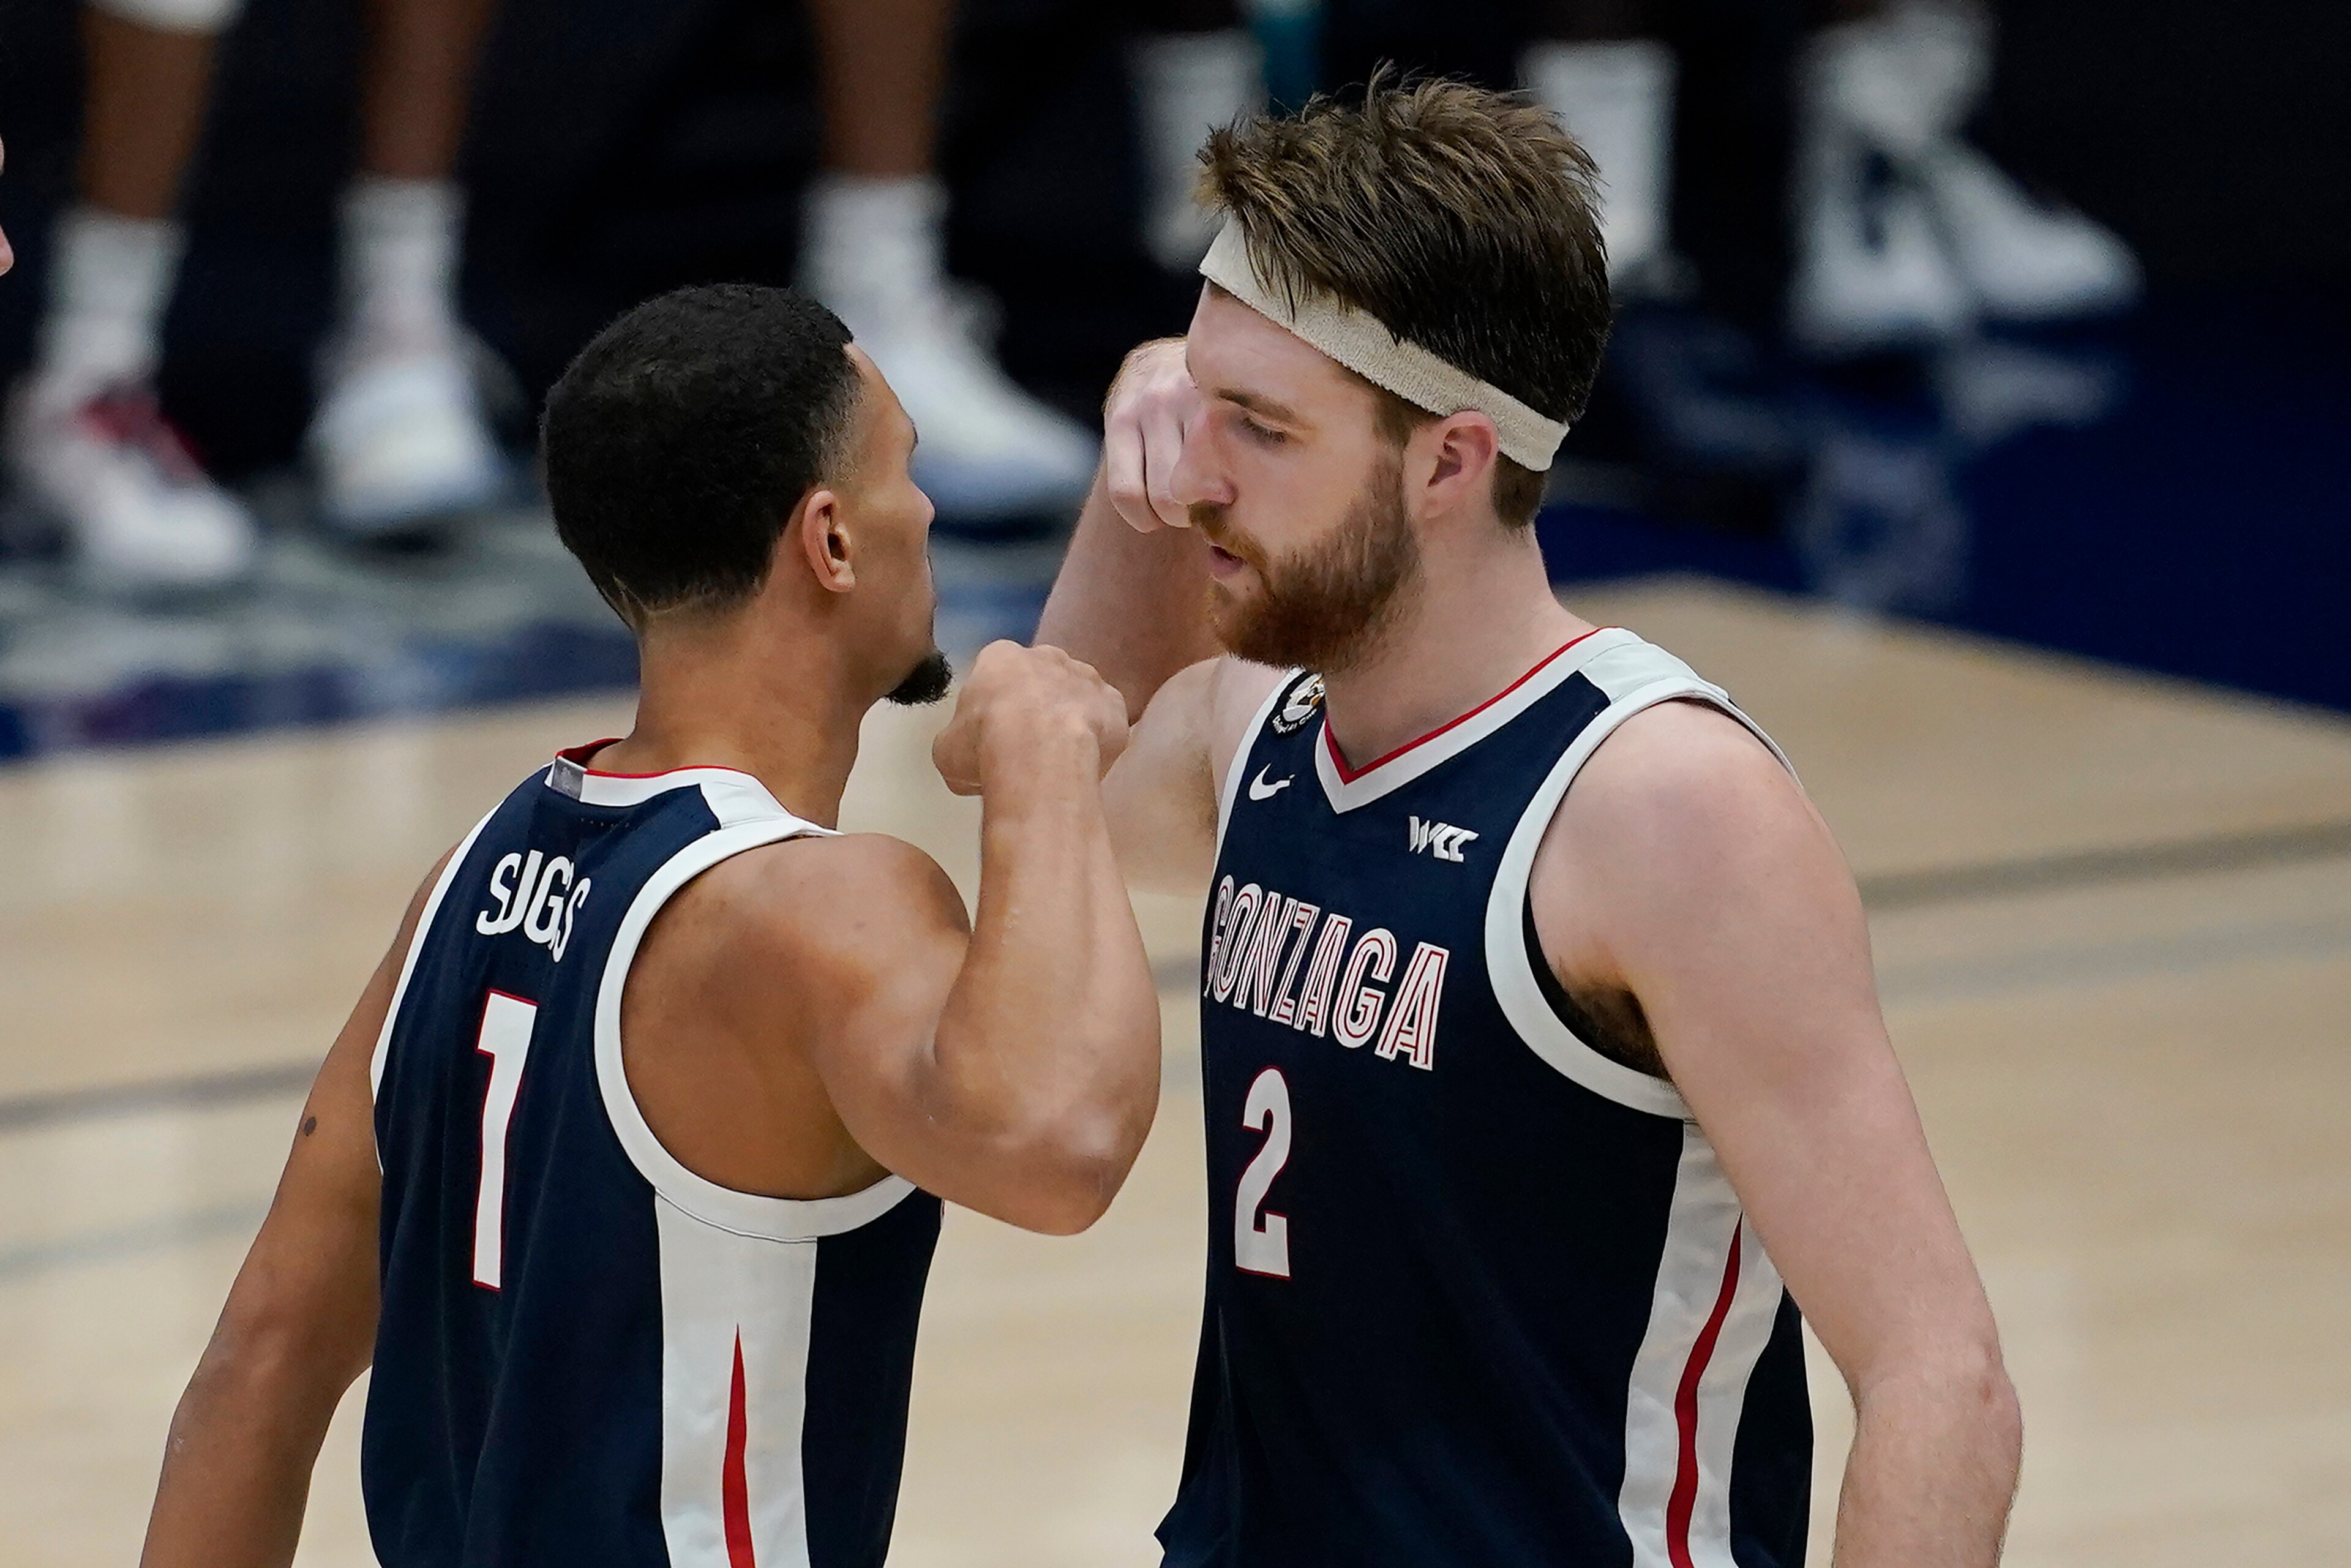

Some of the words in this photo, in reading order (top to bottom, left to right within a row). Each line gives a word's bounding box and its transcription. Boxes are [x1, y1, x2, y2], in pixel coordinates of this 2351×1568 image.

[1409, 816, 1479, 863] WCC
[473, 988, 539, 1292] 1
[1234, 1065, 1292, 1281] 2
